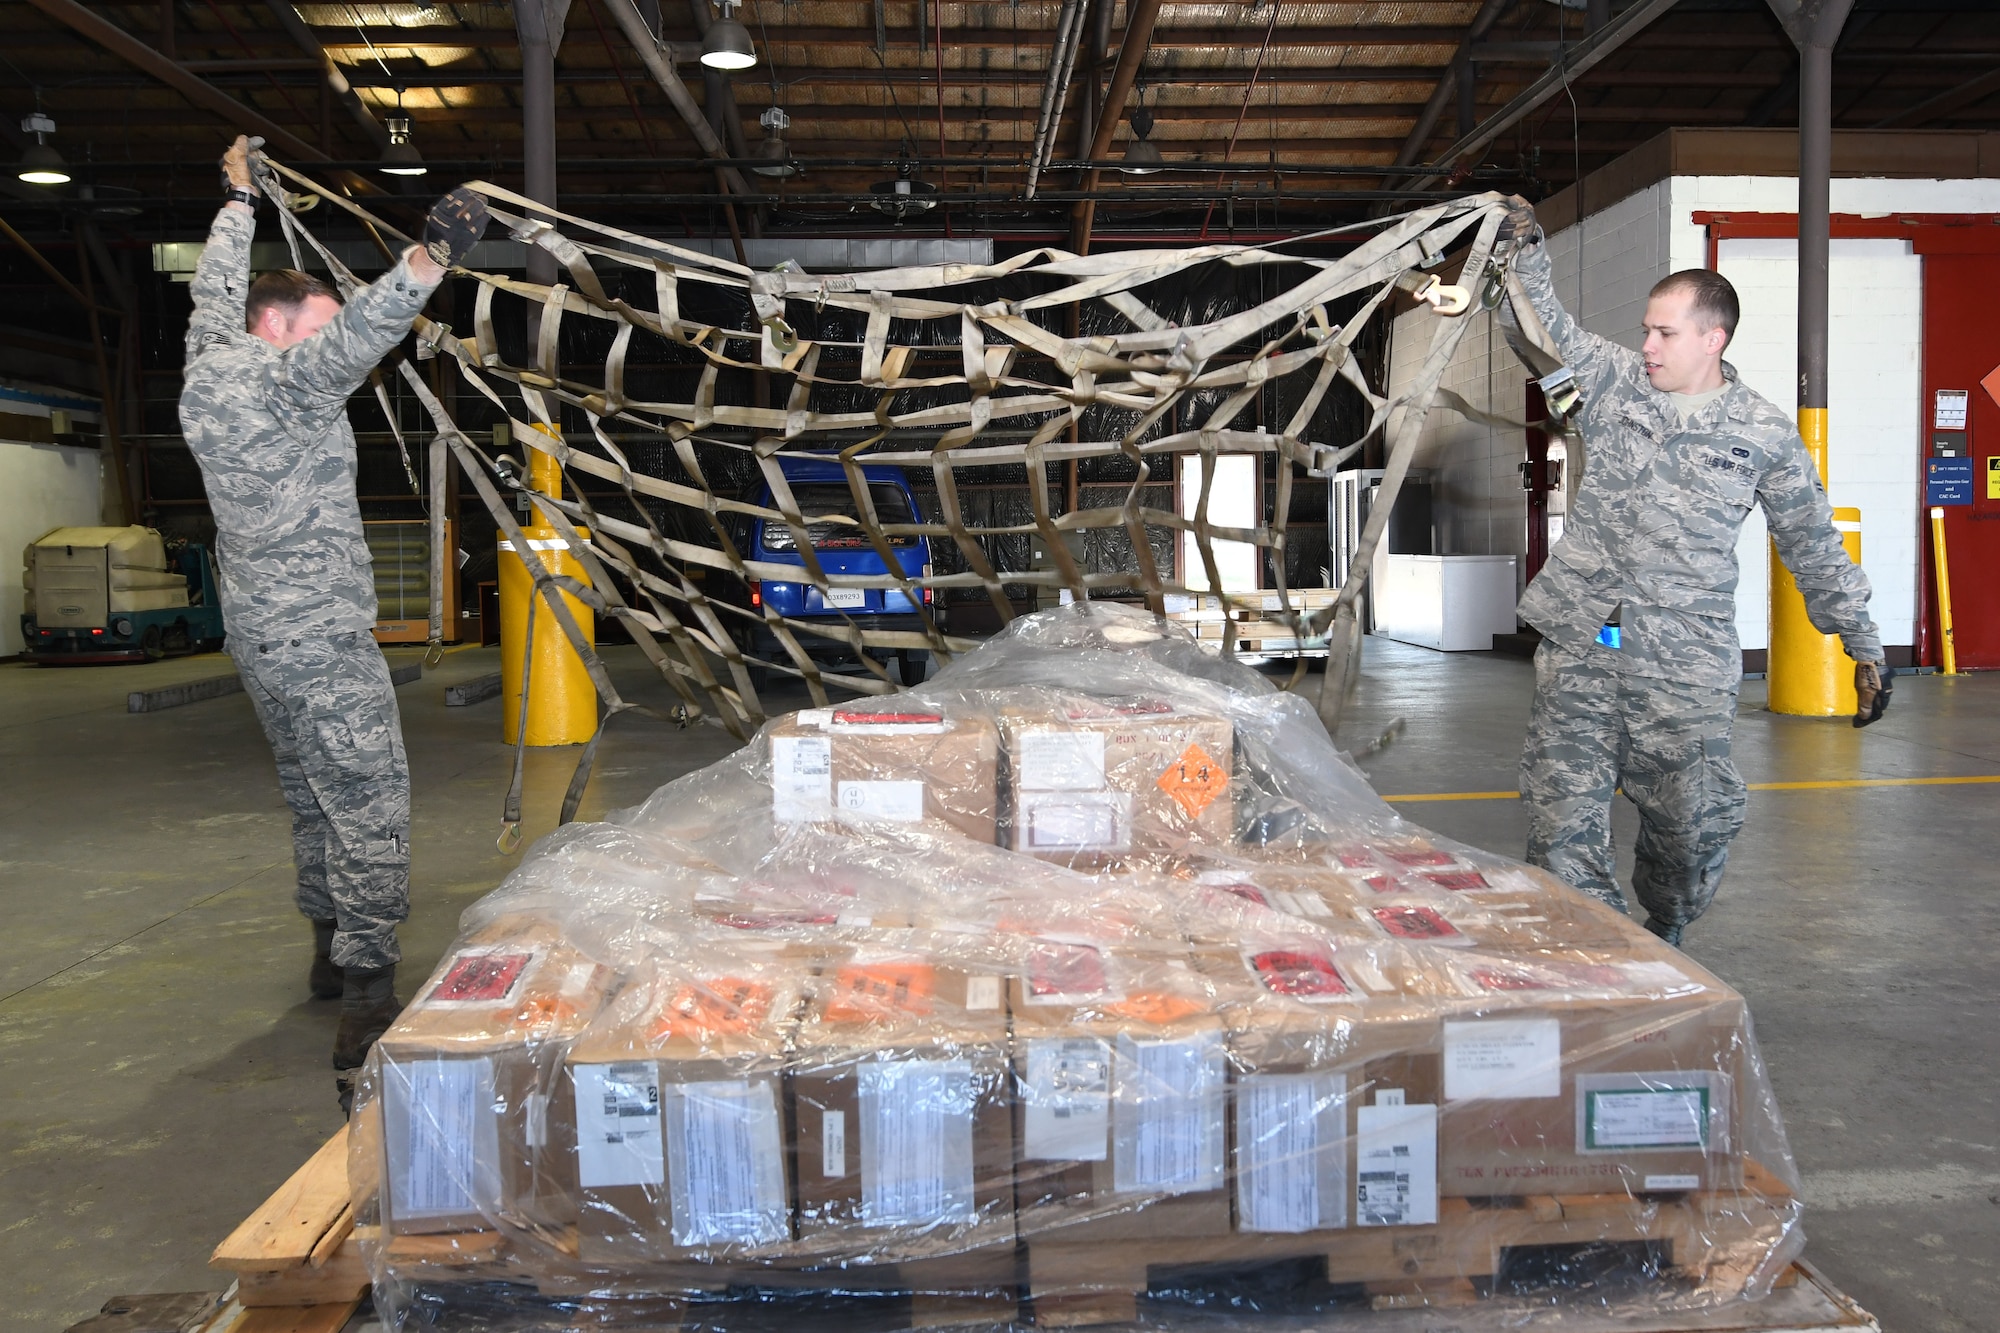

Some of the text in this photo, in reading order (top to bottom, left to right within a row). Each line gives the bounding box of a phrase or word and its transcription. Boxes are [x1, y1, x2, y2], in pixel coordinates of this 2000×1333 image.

[1618, 415, 1654, 439] JOHNSTON
[1721, 459, 1735, 472] AIR
[1735, 464, 1757, 479] FORCE
[1115, 735, 1137, 744] BOX
[1177, 765, 1210, 783] 1.4
[650, 1087, 657, 1100] 2
